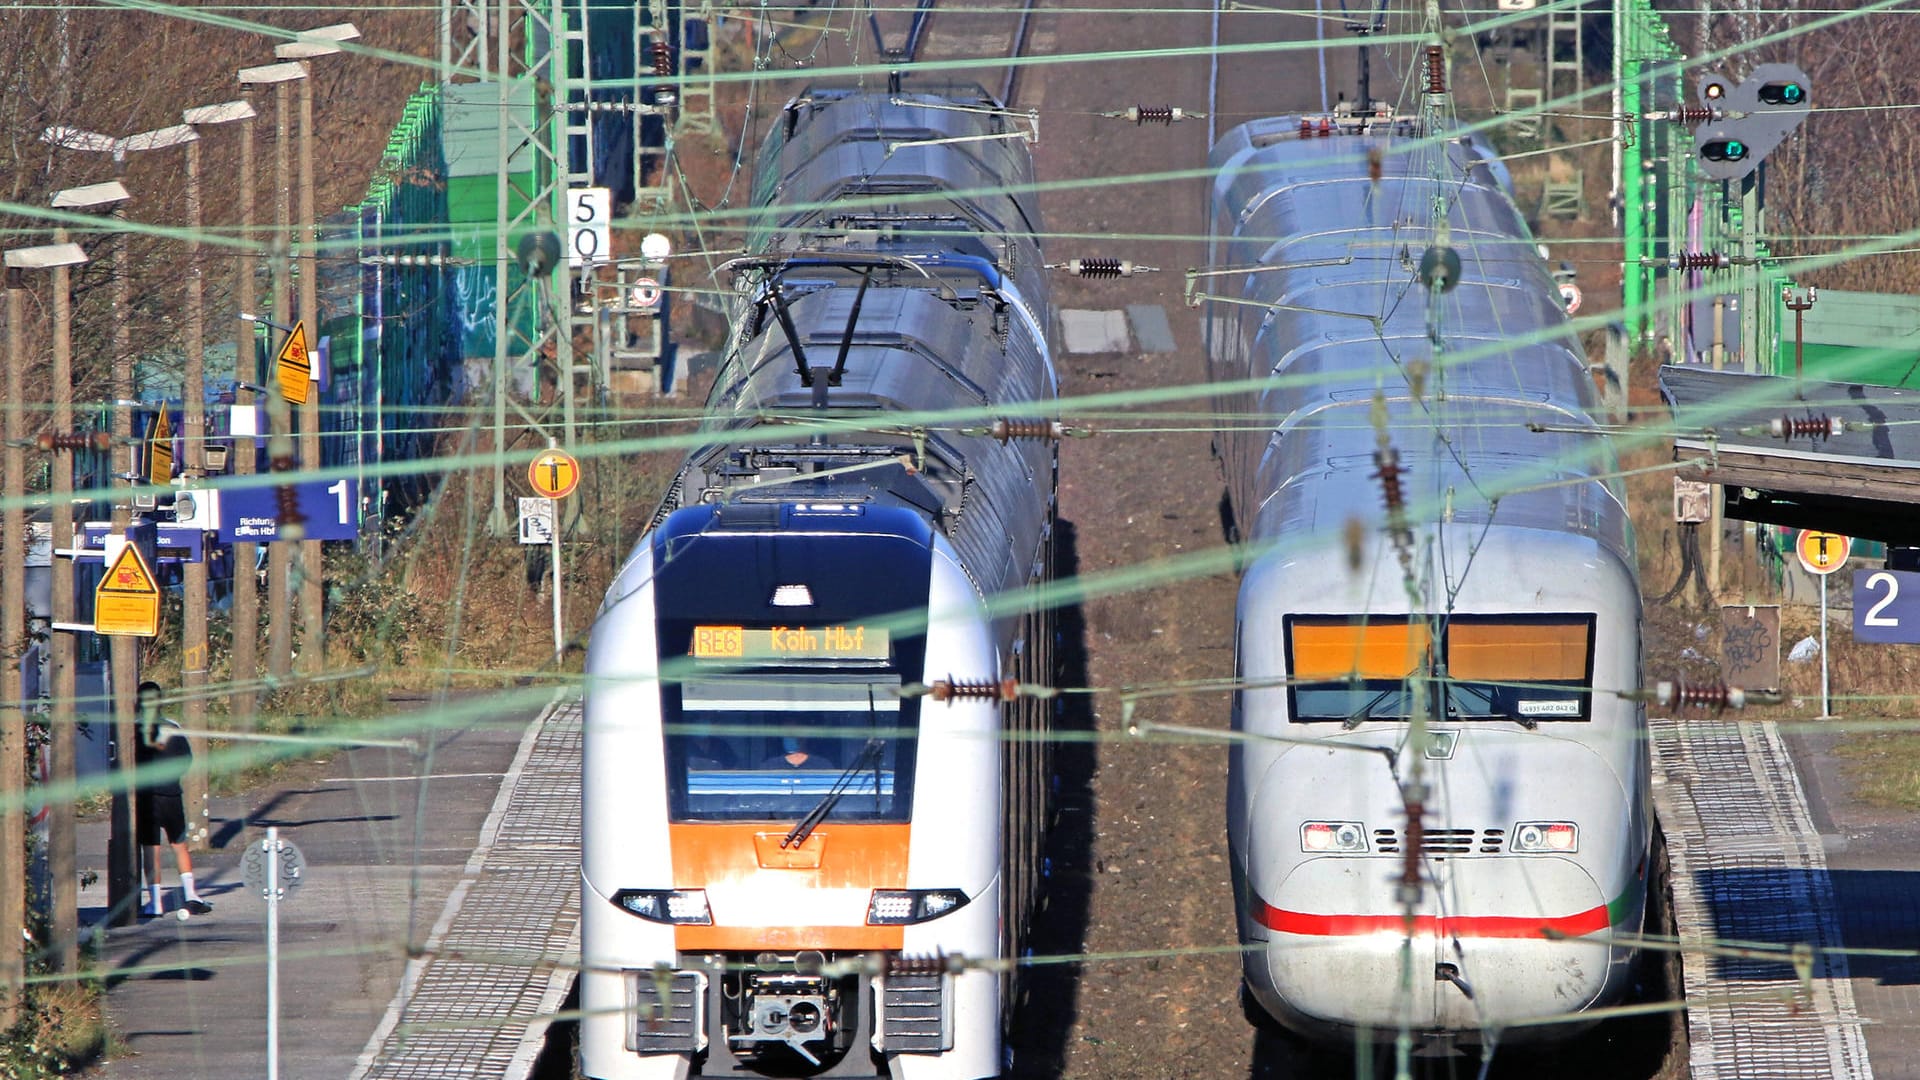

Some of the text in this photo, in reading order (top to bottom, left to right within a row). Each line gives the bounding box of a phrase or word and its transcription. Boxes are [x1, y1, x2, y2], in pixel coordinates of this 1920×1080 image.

[576, 194, 595, 222] 5
[328, 479, 349, 524] 1
[235, 527, 276, 536] Een Hbf
[1864, 572, 1899, 626] 2
[699, 626, 865, 653] RE6 Köln Hbf
